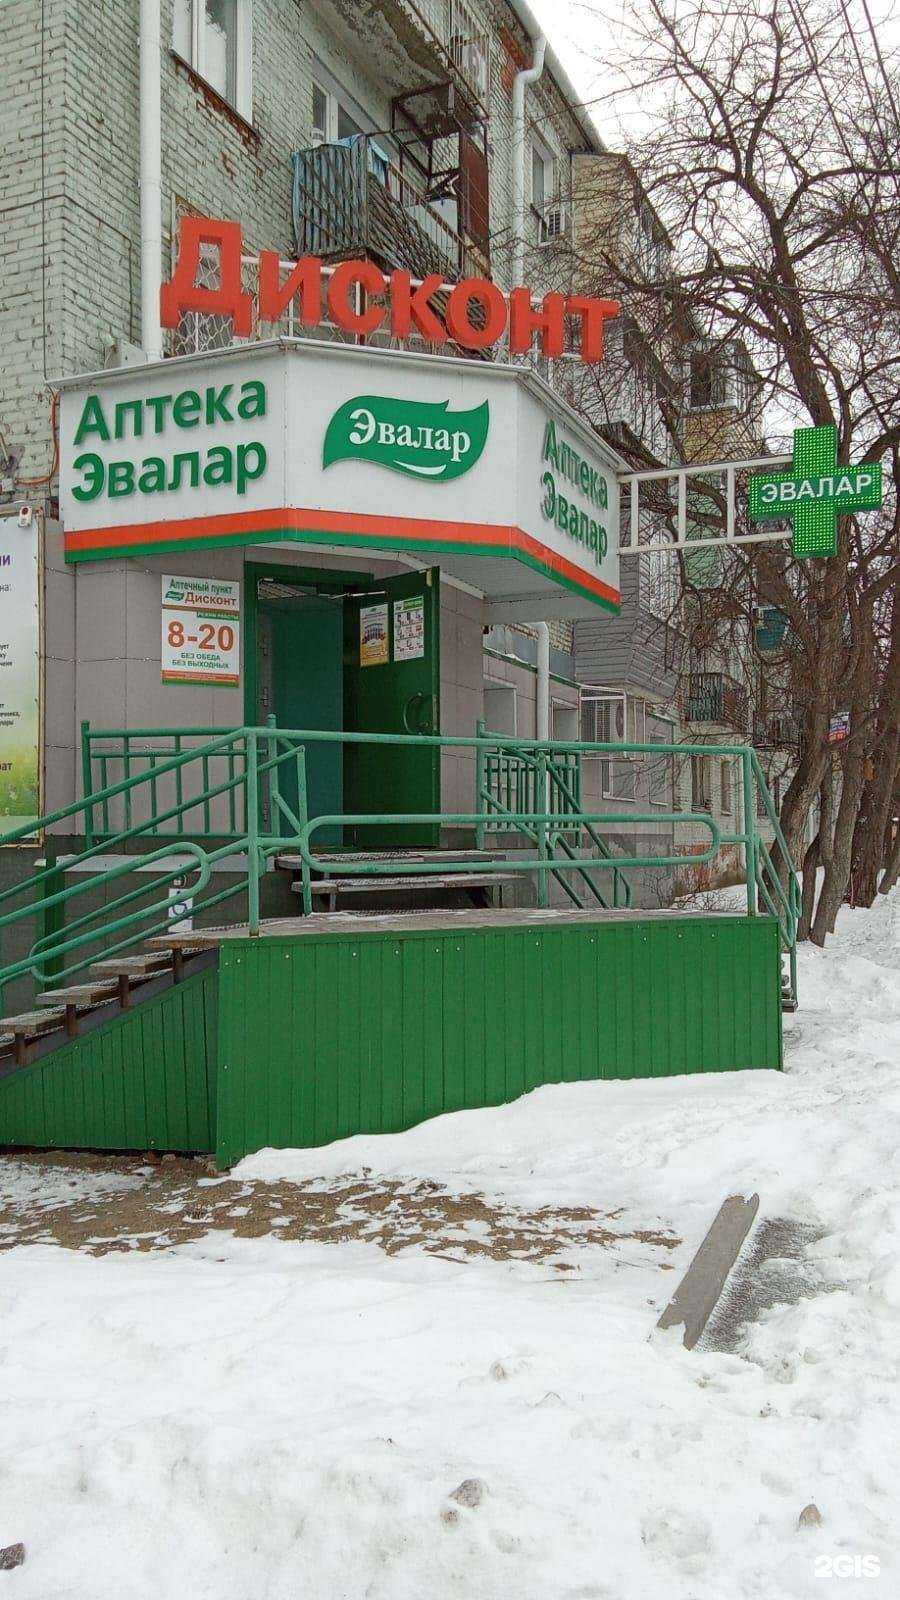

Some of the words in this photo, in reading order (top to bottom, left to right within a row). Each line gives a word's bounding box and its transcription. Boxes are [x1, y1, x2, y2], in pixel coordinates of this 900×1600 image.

[160, 218, 619, 362] Дисконт
[73, 379, 267, 446] Аптека
[349, 407, 471, 463] Эвалар
[71, 440, 267, 502] Эвалар
[543, 419, 609, 511] Аптека
[761, 474, 872, 503] ЭВАЛАР
[541, 471, 608, 566] Эвалар
[169, 579, 210, 592] Аптечный
[211, 584, 233, 595] пункт
[185, 592, 237, 606] Дисконт
[168, 621, 234, 652] 8-20
[196, 653, 220, 661] ОБЕДА
